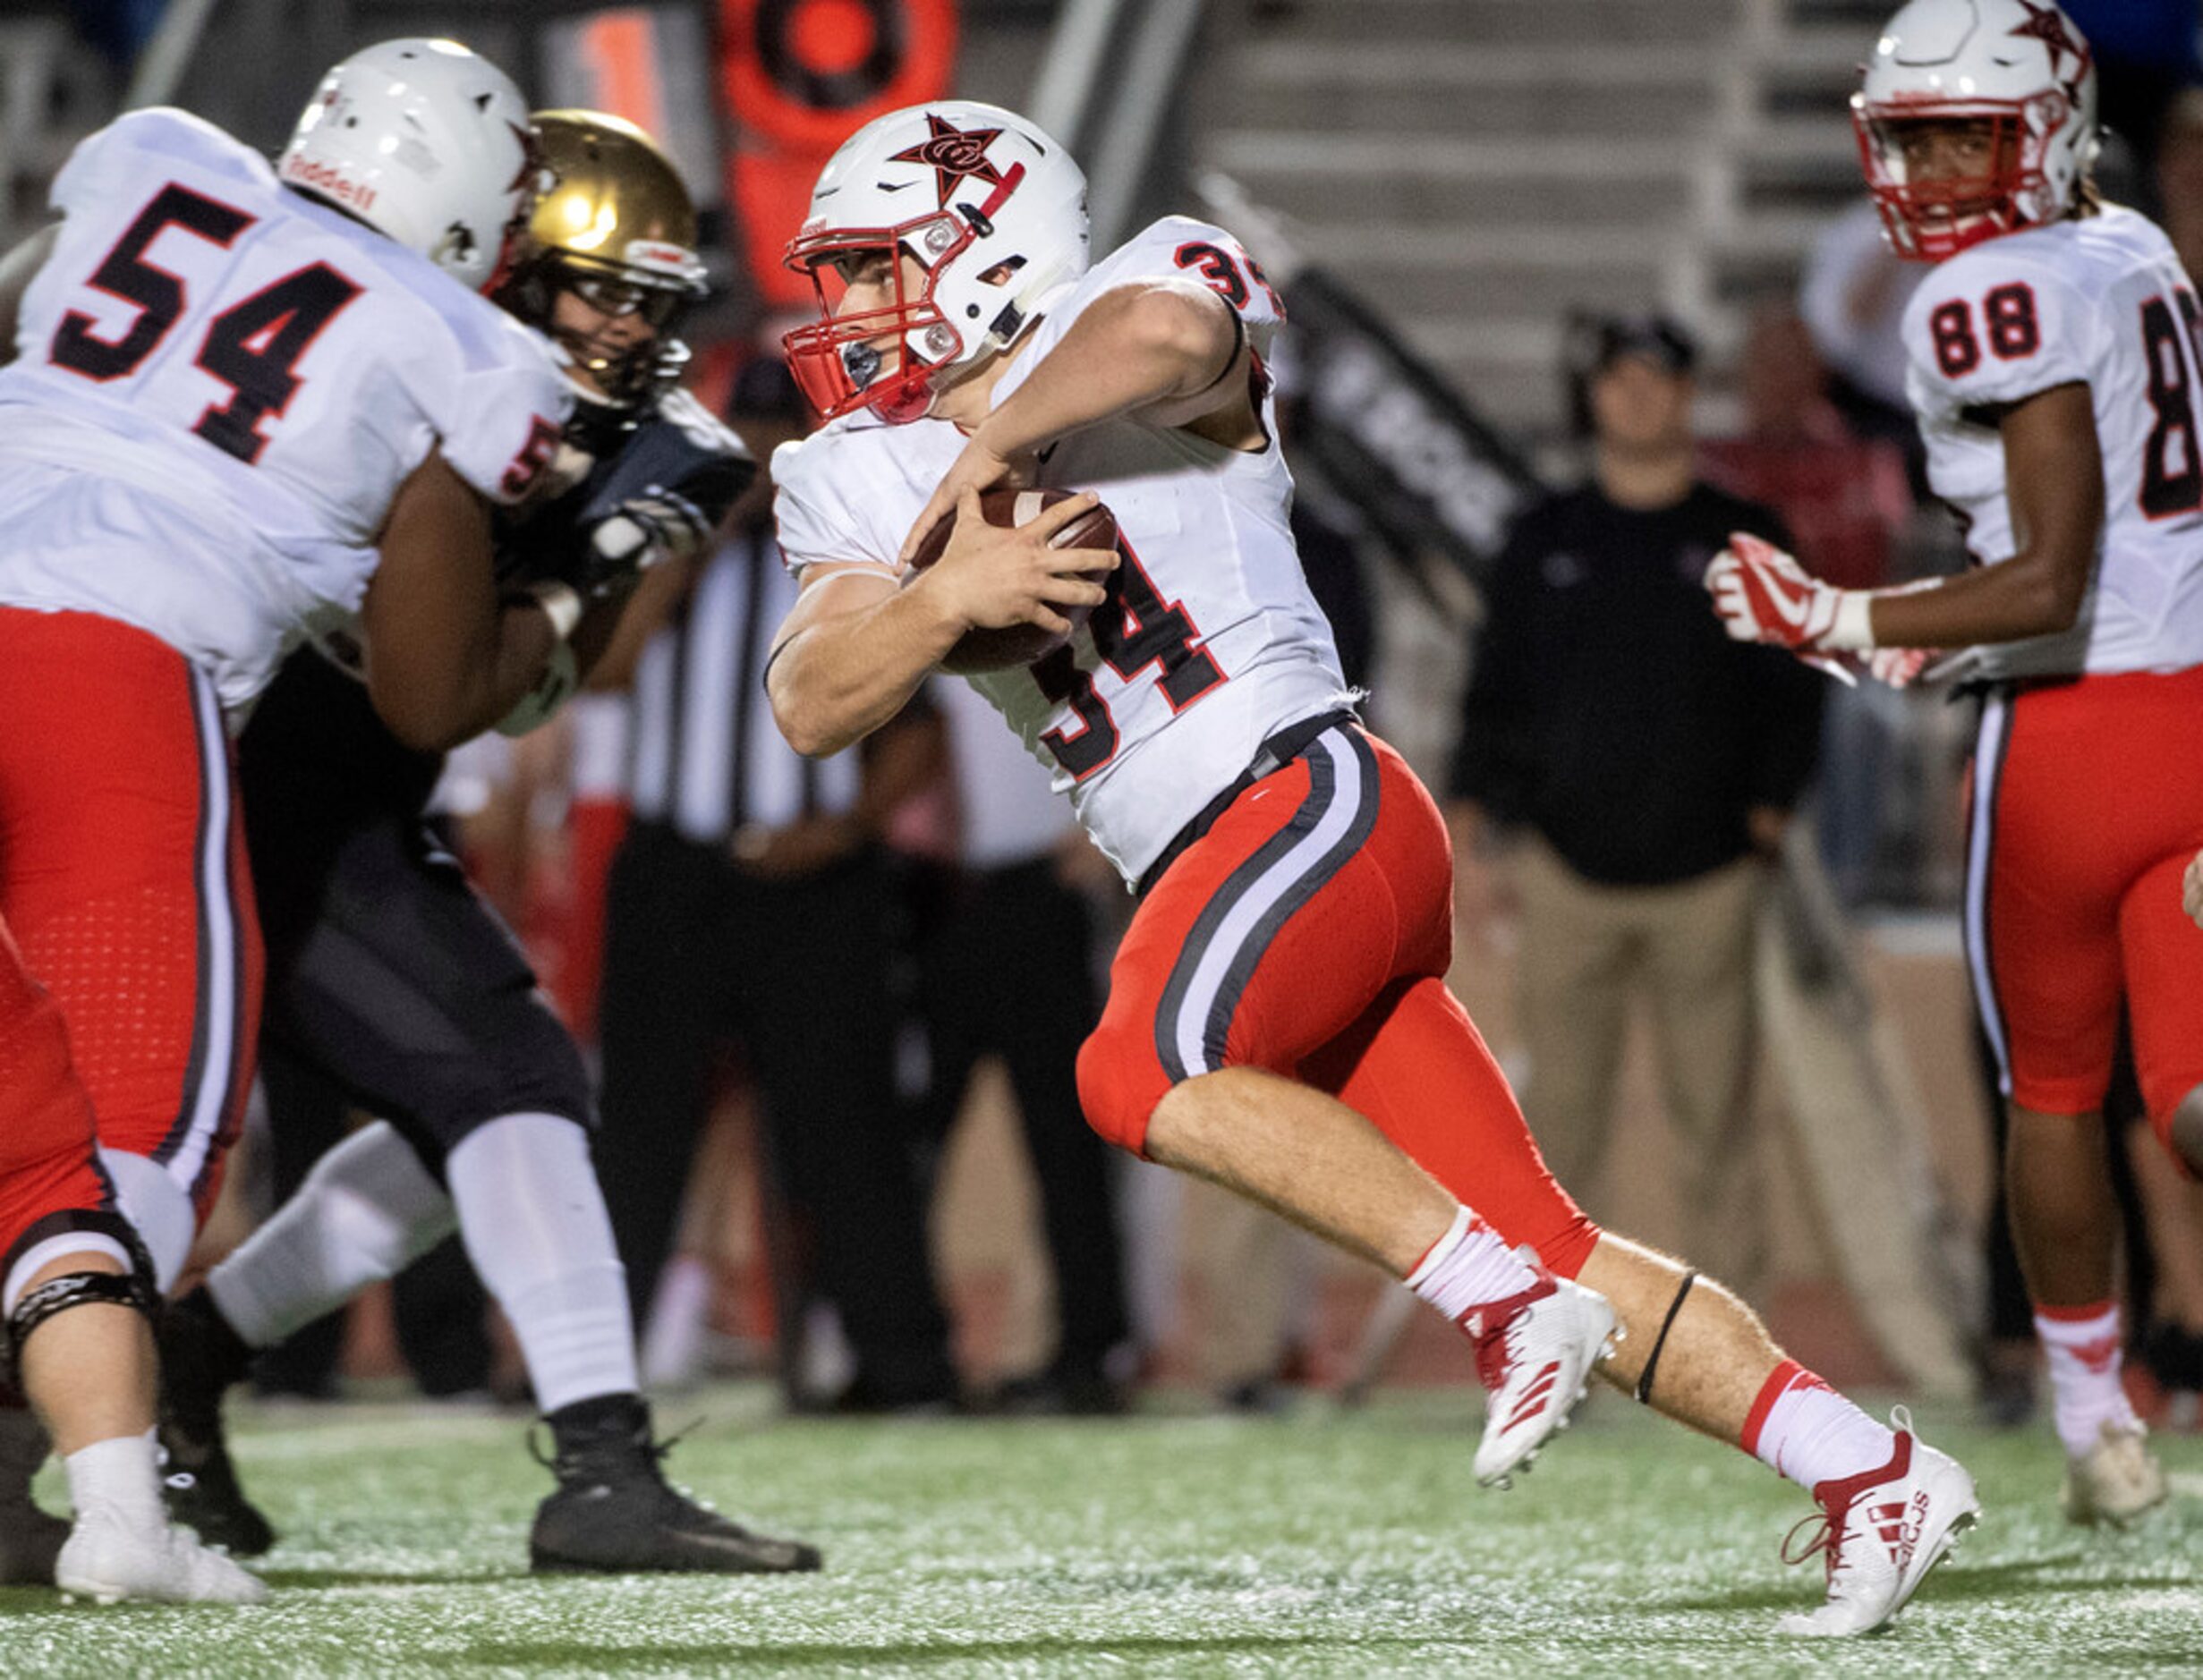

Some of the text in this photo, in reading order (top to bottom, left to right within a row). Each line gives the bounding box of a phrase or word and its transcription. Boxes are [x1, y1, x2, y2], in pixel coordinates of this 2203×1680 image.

[47, 181, 366, 465] 54
[1929, 280, 2042, 381] 88
[2137, 284, 2203, 522] 8
[1898, 1490, 1930, 1572] didas
